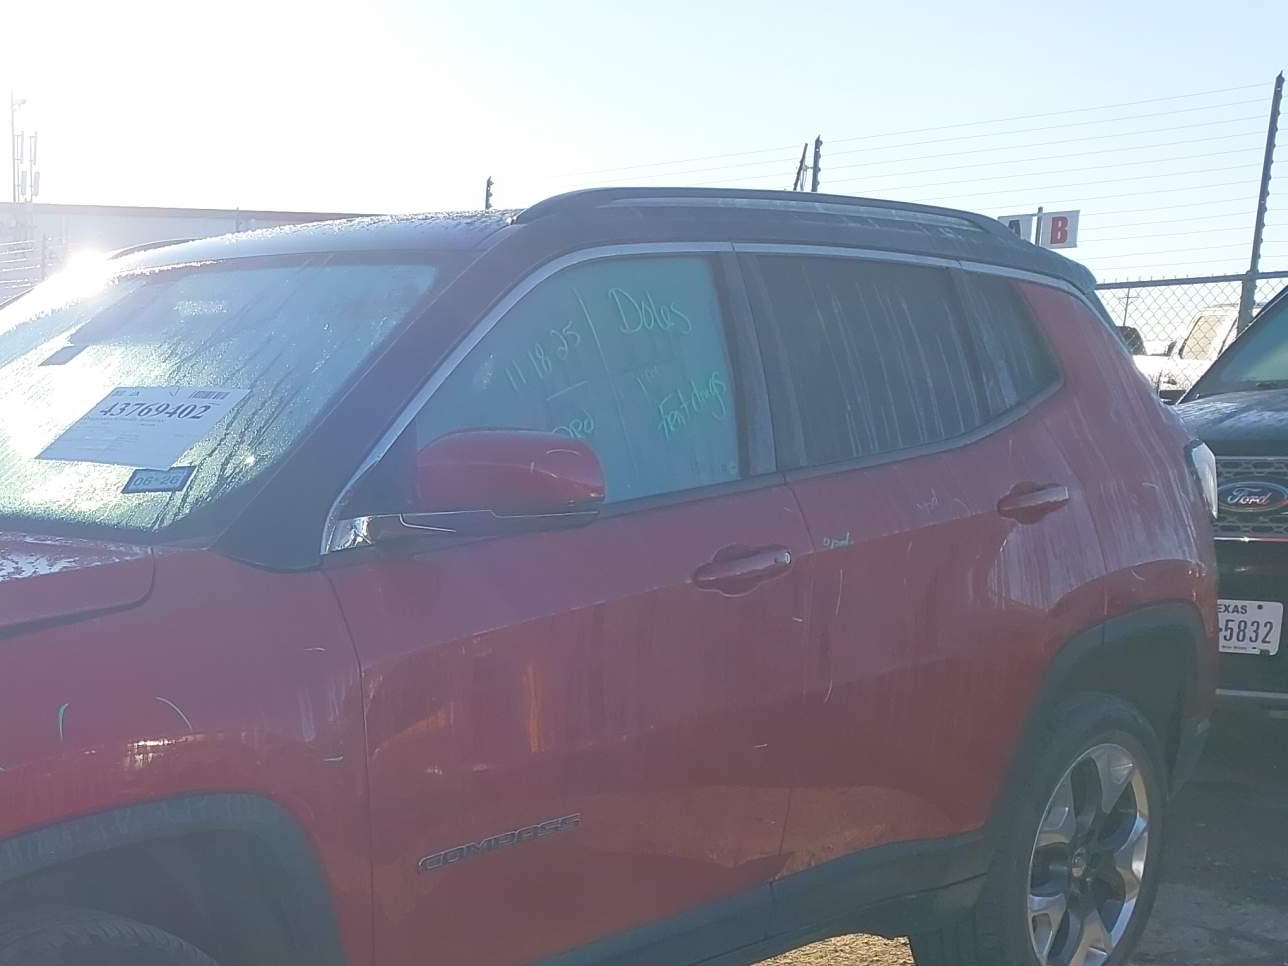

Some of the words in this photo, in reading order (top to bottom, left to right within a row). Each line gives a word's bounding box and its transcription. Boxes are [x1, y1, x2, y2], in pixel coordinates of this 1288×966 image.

[1050, 216, 1069, 245] B
[99, 401, 212, 420] 43769402
[1227, 487, 1272, 506] Ford
[1217, 603, 1248, 615] EXAS
[417, 812, 582, 874] COMPASS
